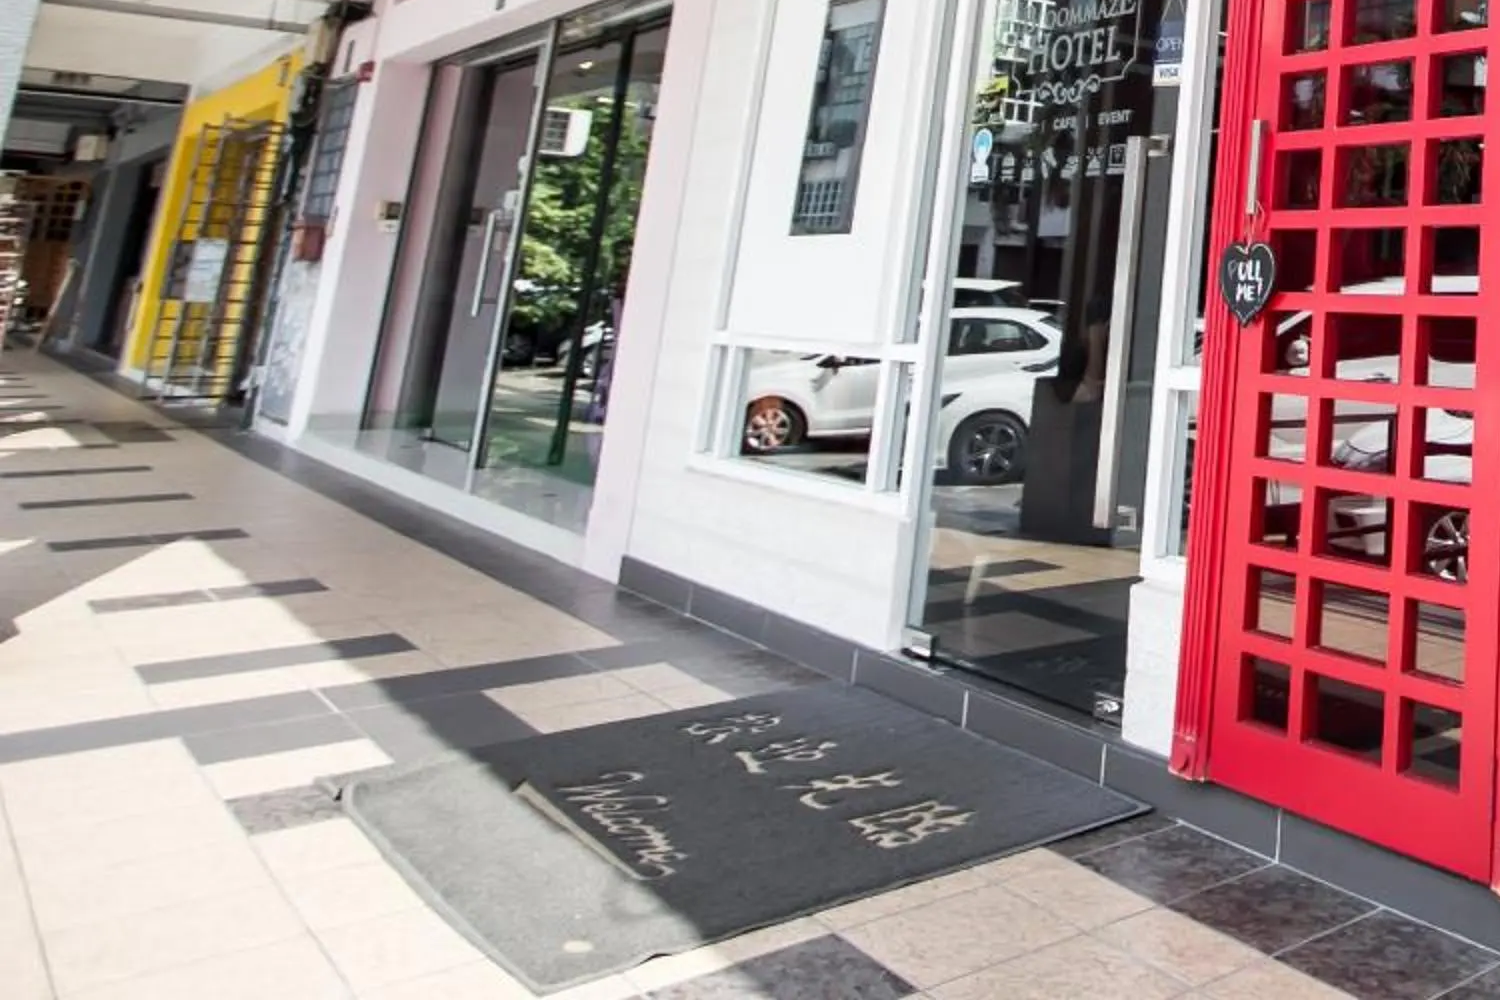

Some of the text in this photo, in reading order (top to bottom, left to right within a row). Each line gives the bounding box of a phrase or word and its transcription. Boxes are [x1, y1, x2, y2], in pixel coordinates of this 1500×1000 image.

[1025, 25, 1121, 75] HOTEL
[1097, 109, 1135, 125] EVENT
[1227, 260, 1263, 281] PULL
[556, 771, 687, 880] Welcome
